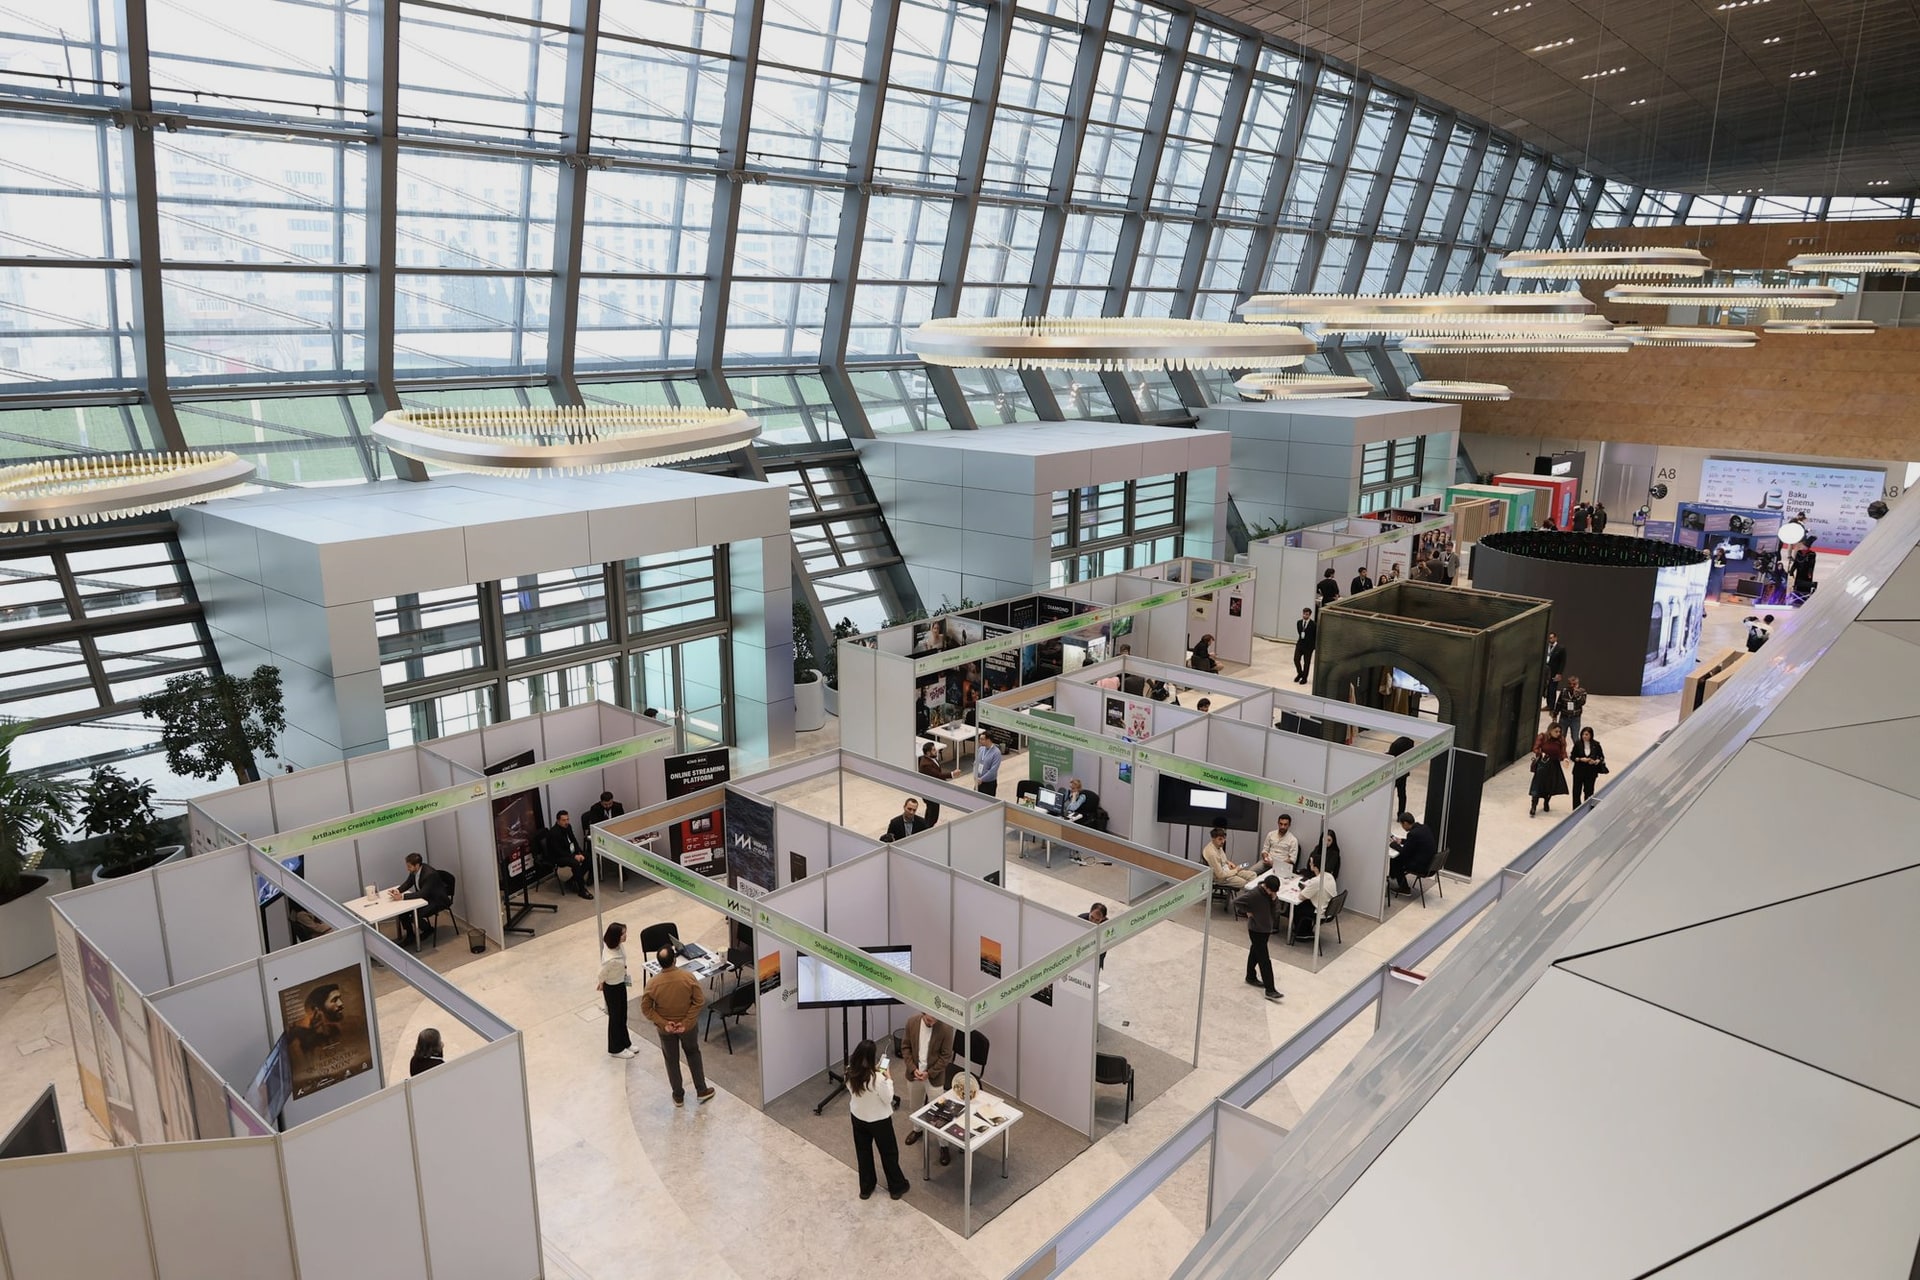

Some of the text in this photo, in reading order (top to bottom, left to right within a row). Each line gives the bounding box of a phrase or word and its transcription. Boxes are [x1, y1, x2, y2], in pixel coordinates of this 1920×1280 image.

[1657, 468, 1677, 480] A8
[1786, 498, 1814, 507] Cinema
[1788, 490, 1807, 499] Baku
[1786, 506, 1811, 514] Breeze
[1015, 719, 1039, 732] Azerbaijan
[1038, 725, 1062, 737] Animation
[1108, 743, 1131, 756] anima
[549, 749, 623, 774] Kinobox Streaming Platform
[670, 764, 725, 780] ONLINE STREAMING
[682, 773, 714, 785] PLATFORM
[1203, 771, 1248, 788] 3Dost Animation
[1305, 798, 1325, 811] 3Dost
[312, 800, 439, 842] ArtBakers Creative Advertising Agency
[669, 872, 696, 889] Production
[1130, 894, 1185, 926] Chinar Film Production
[814, 940, 893, 983] Shahdagh Film Production
[1000, 954, 1073, 1000] Shahdagh Film Production
